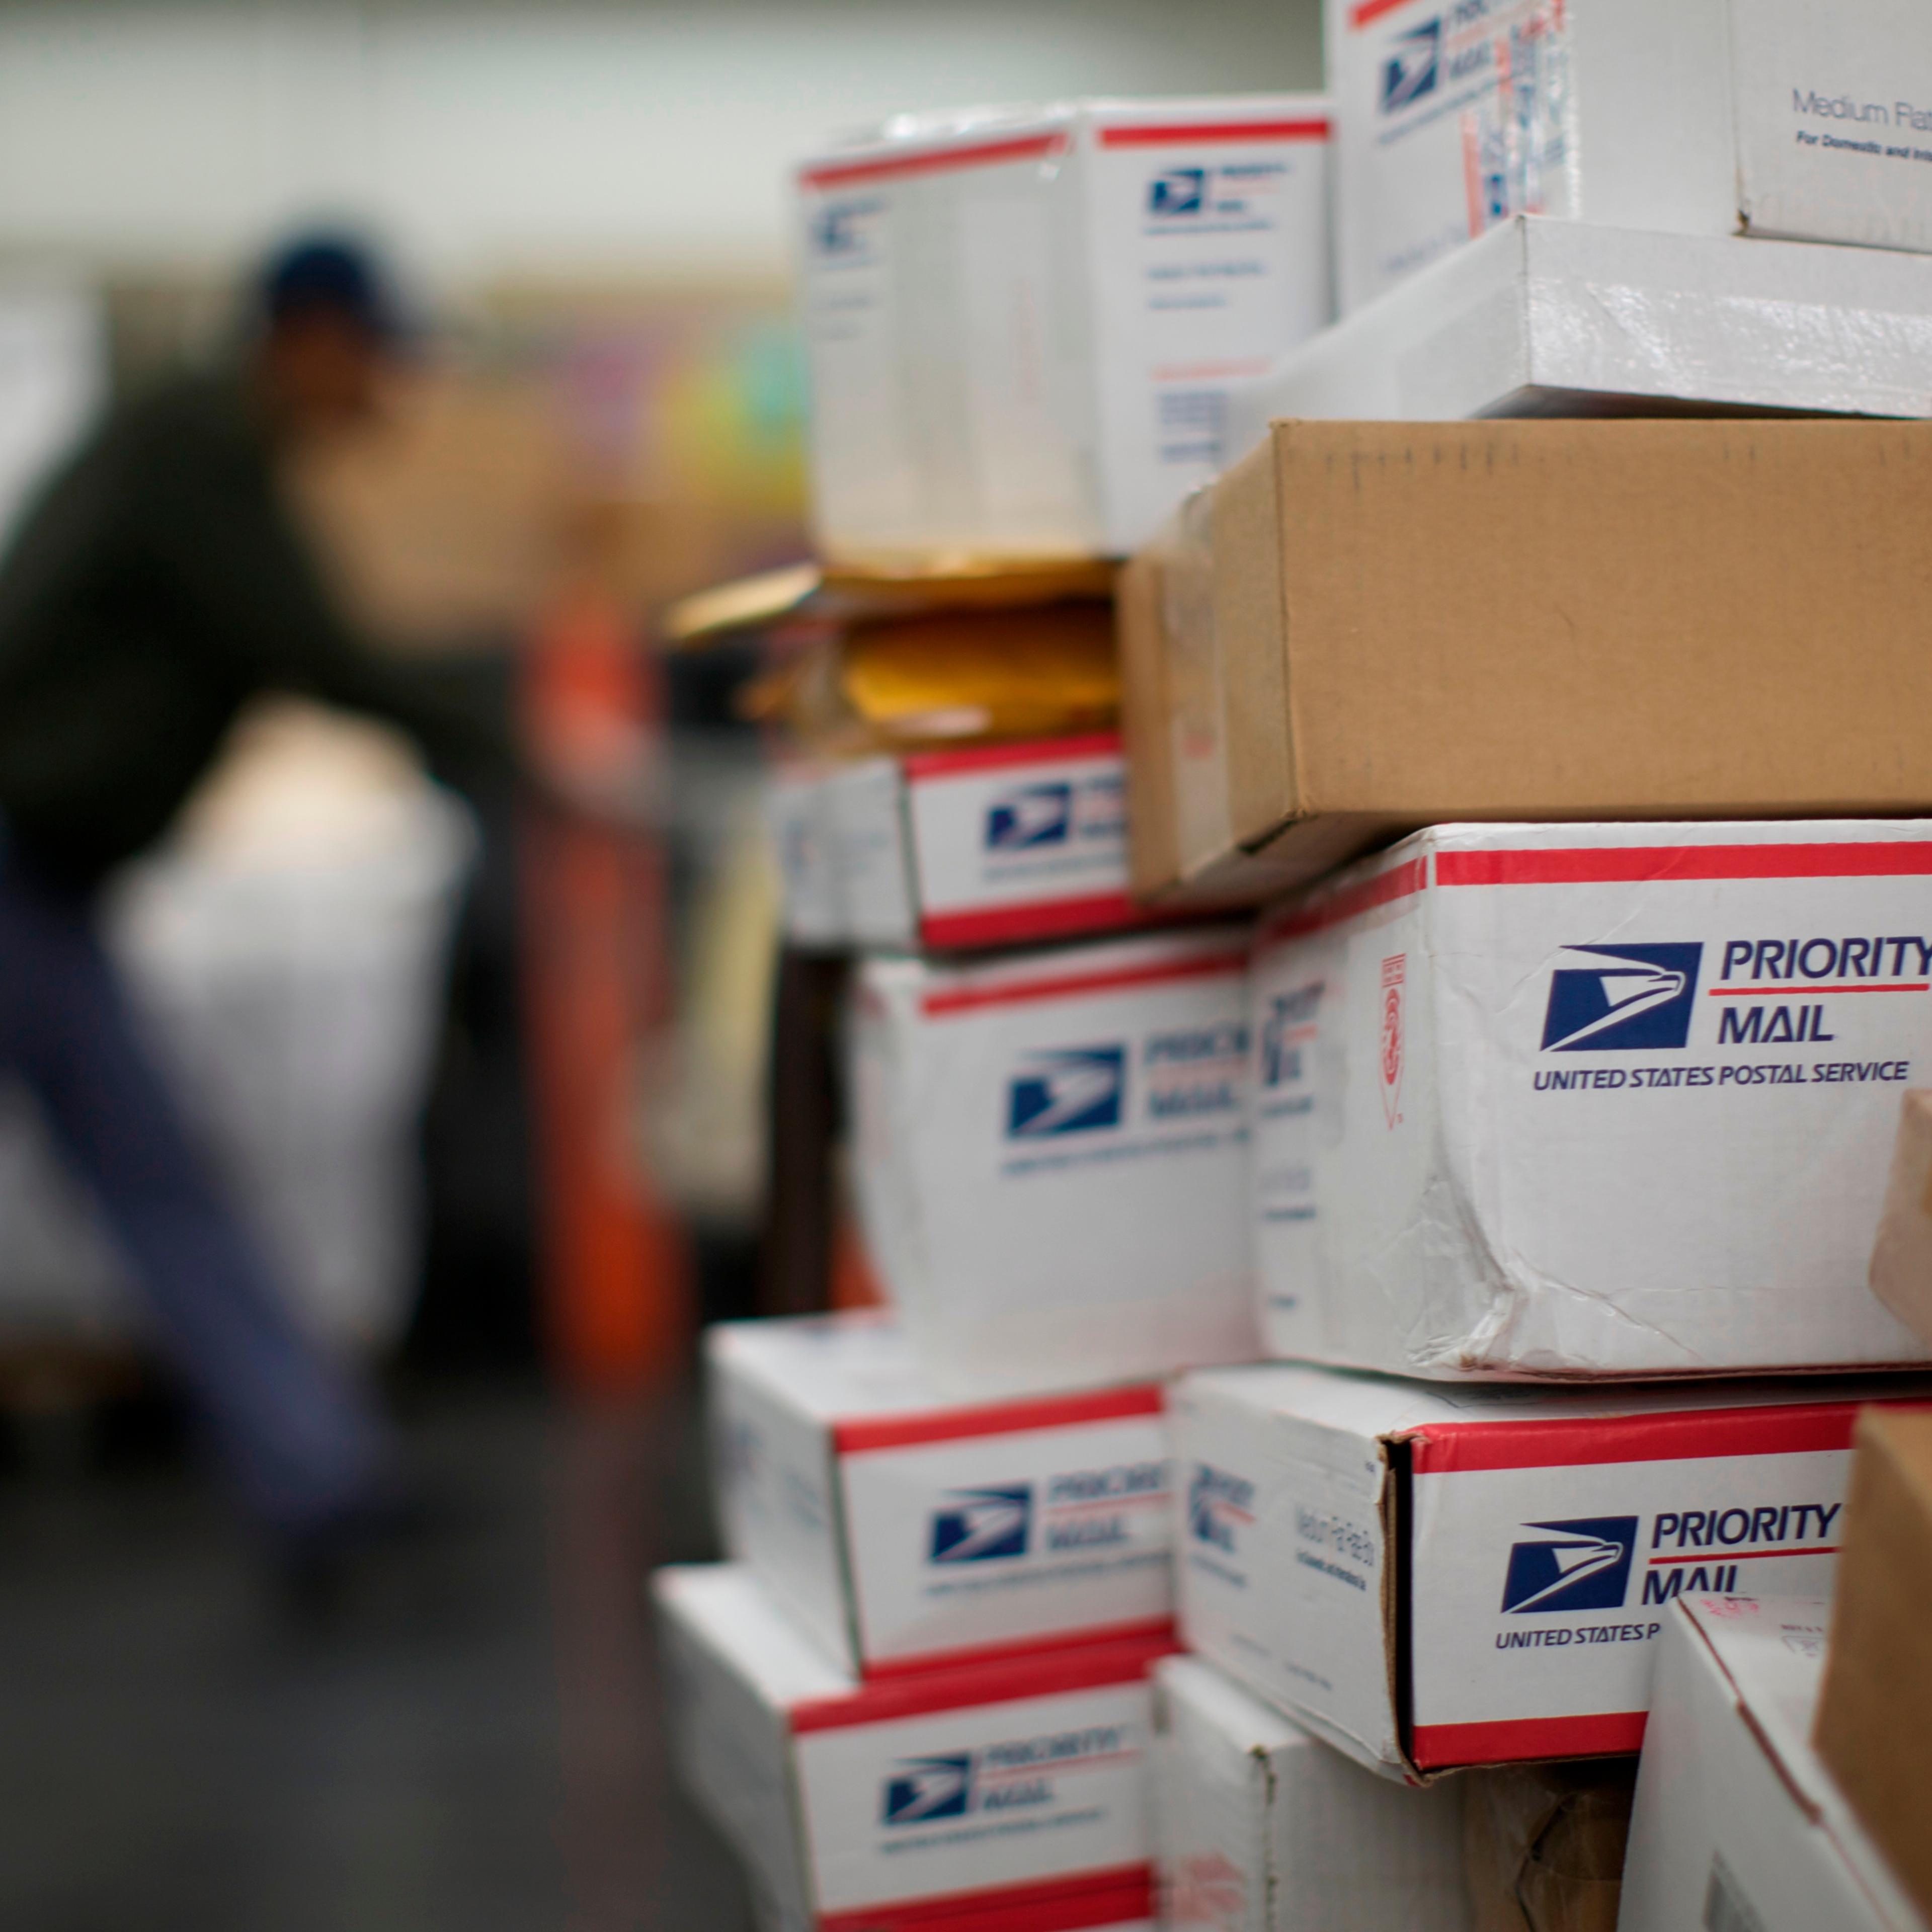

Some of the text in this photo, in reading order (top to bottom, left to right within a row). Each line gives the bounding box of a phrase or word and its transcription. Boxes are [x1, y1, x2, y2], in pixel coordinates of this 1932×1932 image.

[1793, 88, 1889, 125] Medium
[1720, 936, 1932, 980] PRIORITY
[1717, 1005, 1834, 1044] MAIL
[1533, 1061, 1910, 1091] UNITED STATES POSTAL SERVICE
[1651, 1502, 1842, 1549] PRIORITY
[1495, 1629, 1573, 1649] UNITED
[1574, 1624, 1644, 1644] STATES
